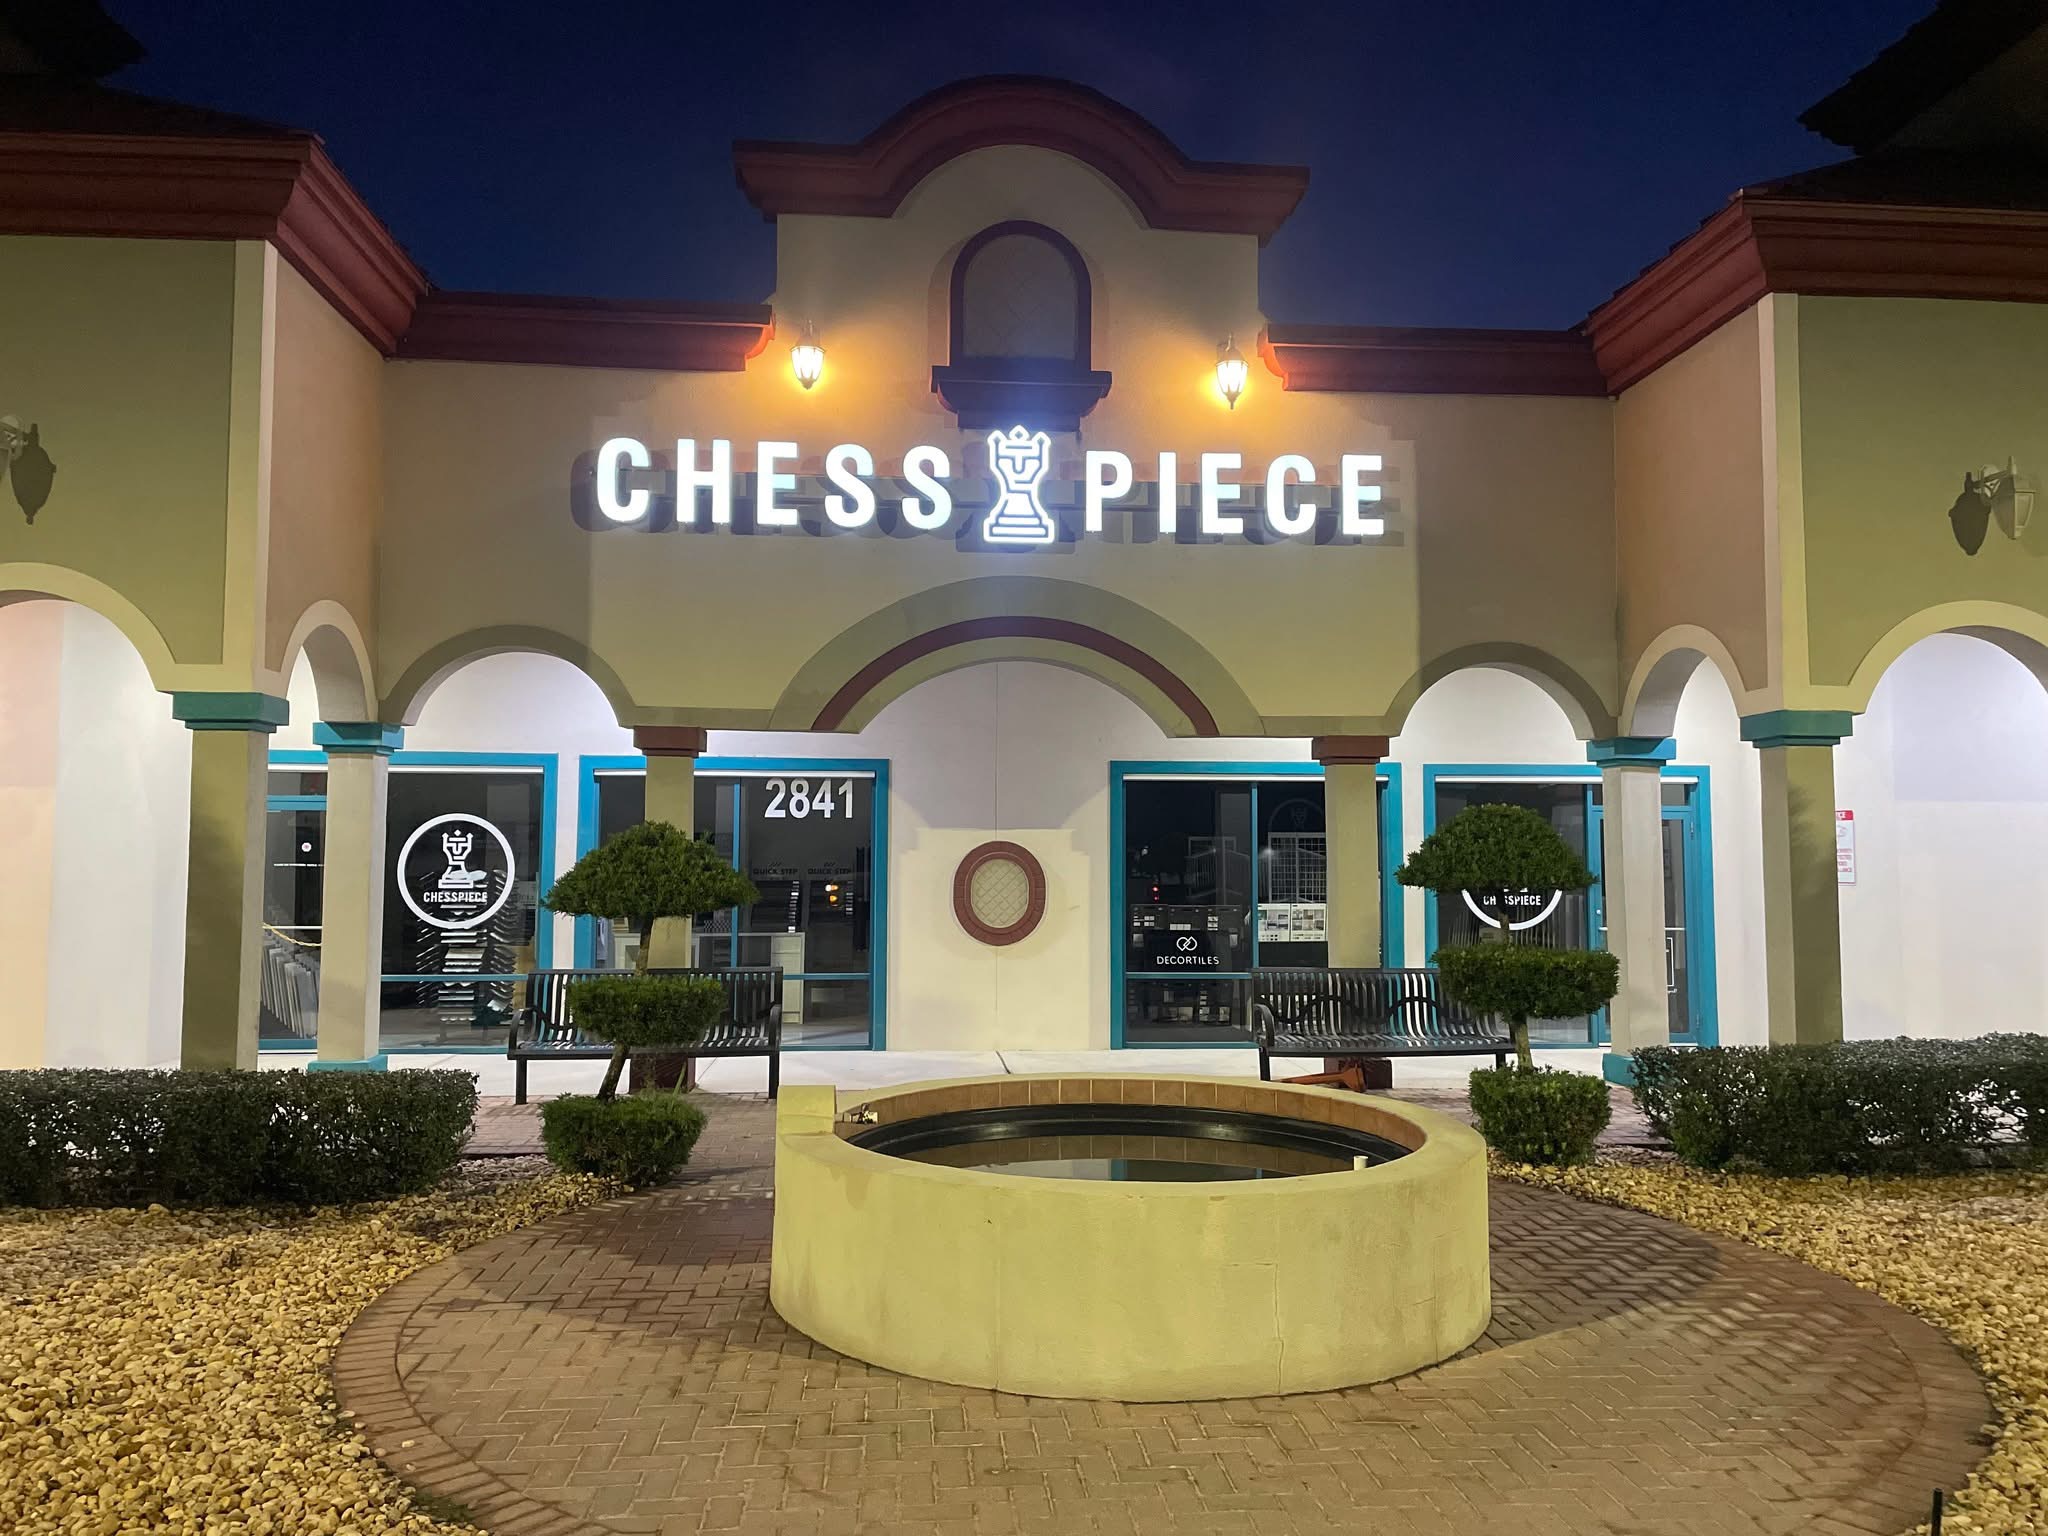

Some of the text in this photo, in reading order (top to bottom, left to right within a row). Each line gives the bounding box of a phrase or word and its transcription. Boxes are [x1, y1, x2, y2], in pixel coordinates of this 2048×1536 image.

[596, 437, 1384, 536] CHESS PIECE
[764, 777, 854, 819] 2841
[423, 891, 488, 903] CHESSPIECE
[1483, 895, 1542, 906] CHSPIECE
[1156, 956, 1220, 965] DECORTILES
